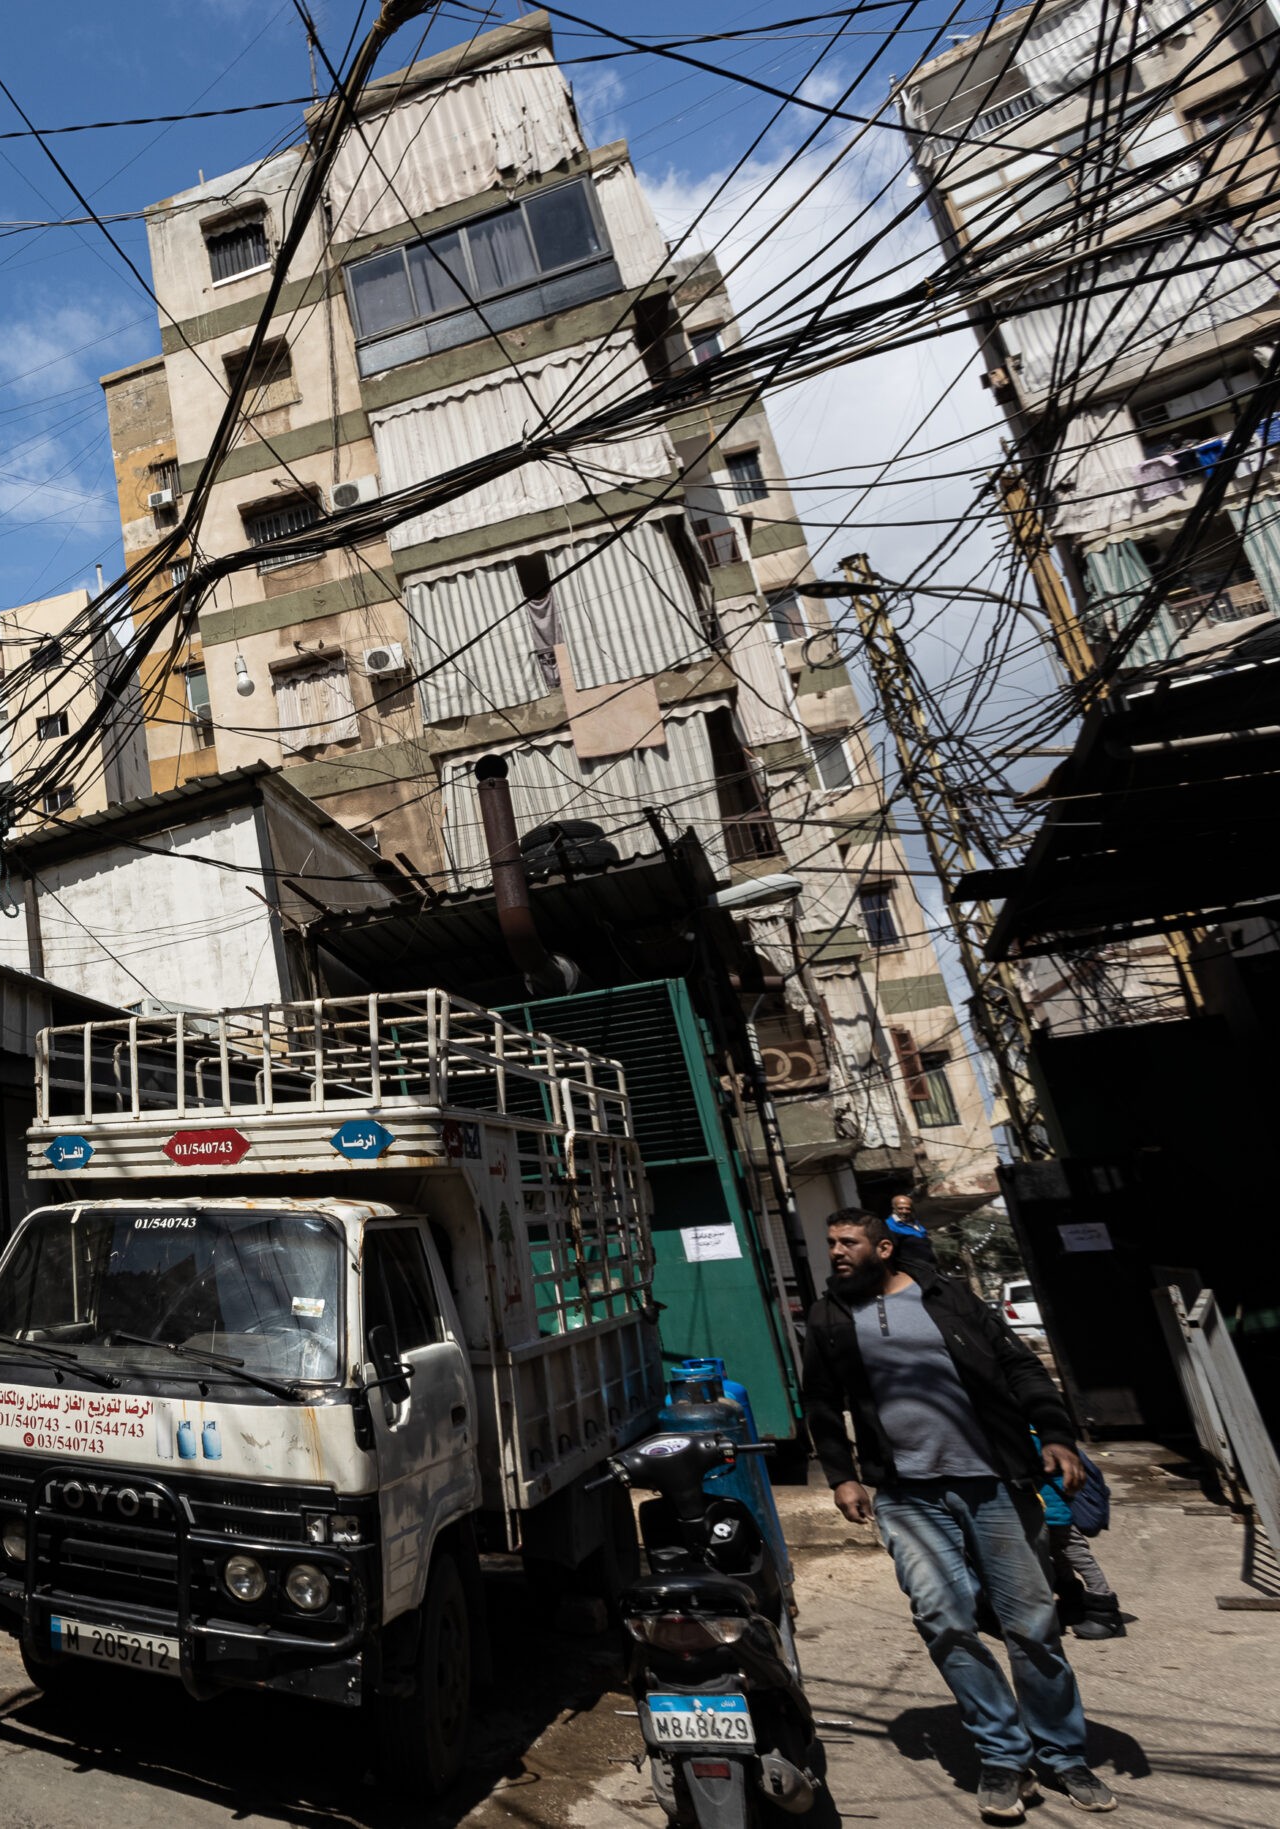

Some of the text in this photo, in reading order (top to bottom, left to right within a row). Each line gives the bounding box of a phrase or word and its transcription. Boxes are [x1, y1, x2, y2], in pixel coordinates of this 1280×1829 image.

[174, 1140, 234, 1156] 01/540743
[340, 1133, 378, 1151] الرضا
[58, 1146, 85, 1162] للغاز
[134, 1217, 197, 1230] 01/540743
[26, 1392, 61, 1412] للمنازل
[62, 1394, 86, 1414] الغاز
[87, 1396, 122, 1418] لتوزيع
[124, 1398, 154, 1419] الرضا
[74, 1418, 145, 1438] 01/544743
[37, 1433, 105, 1454] 03/540743
[66, 1624, 171, 1671] M 205212
[656, 1716, 749, 1740] M848429
